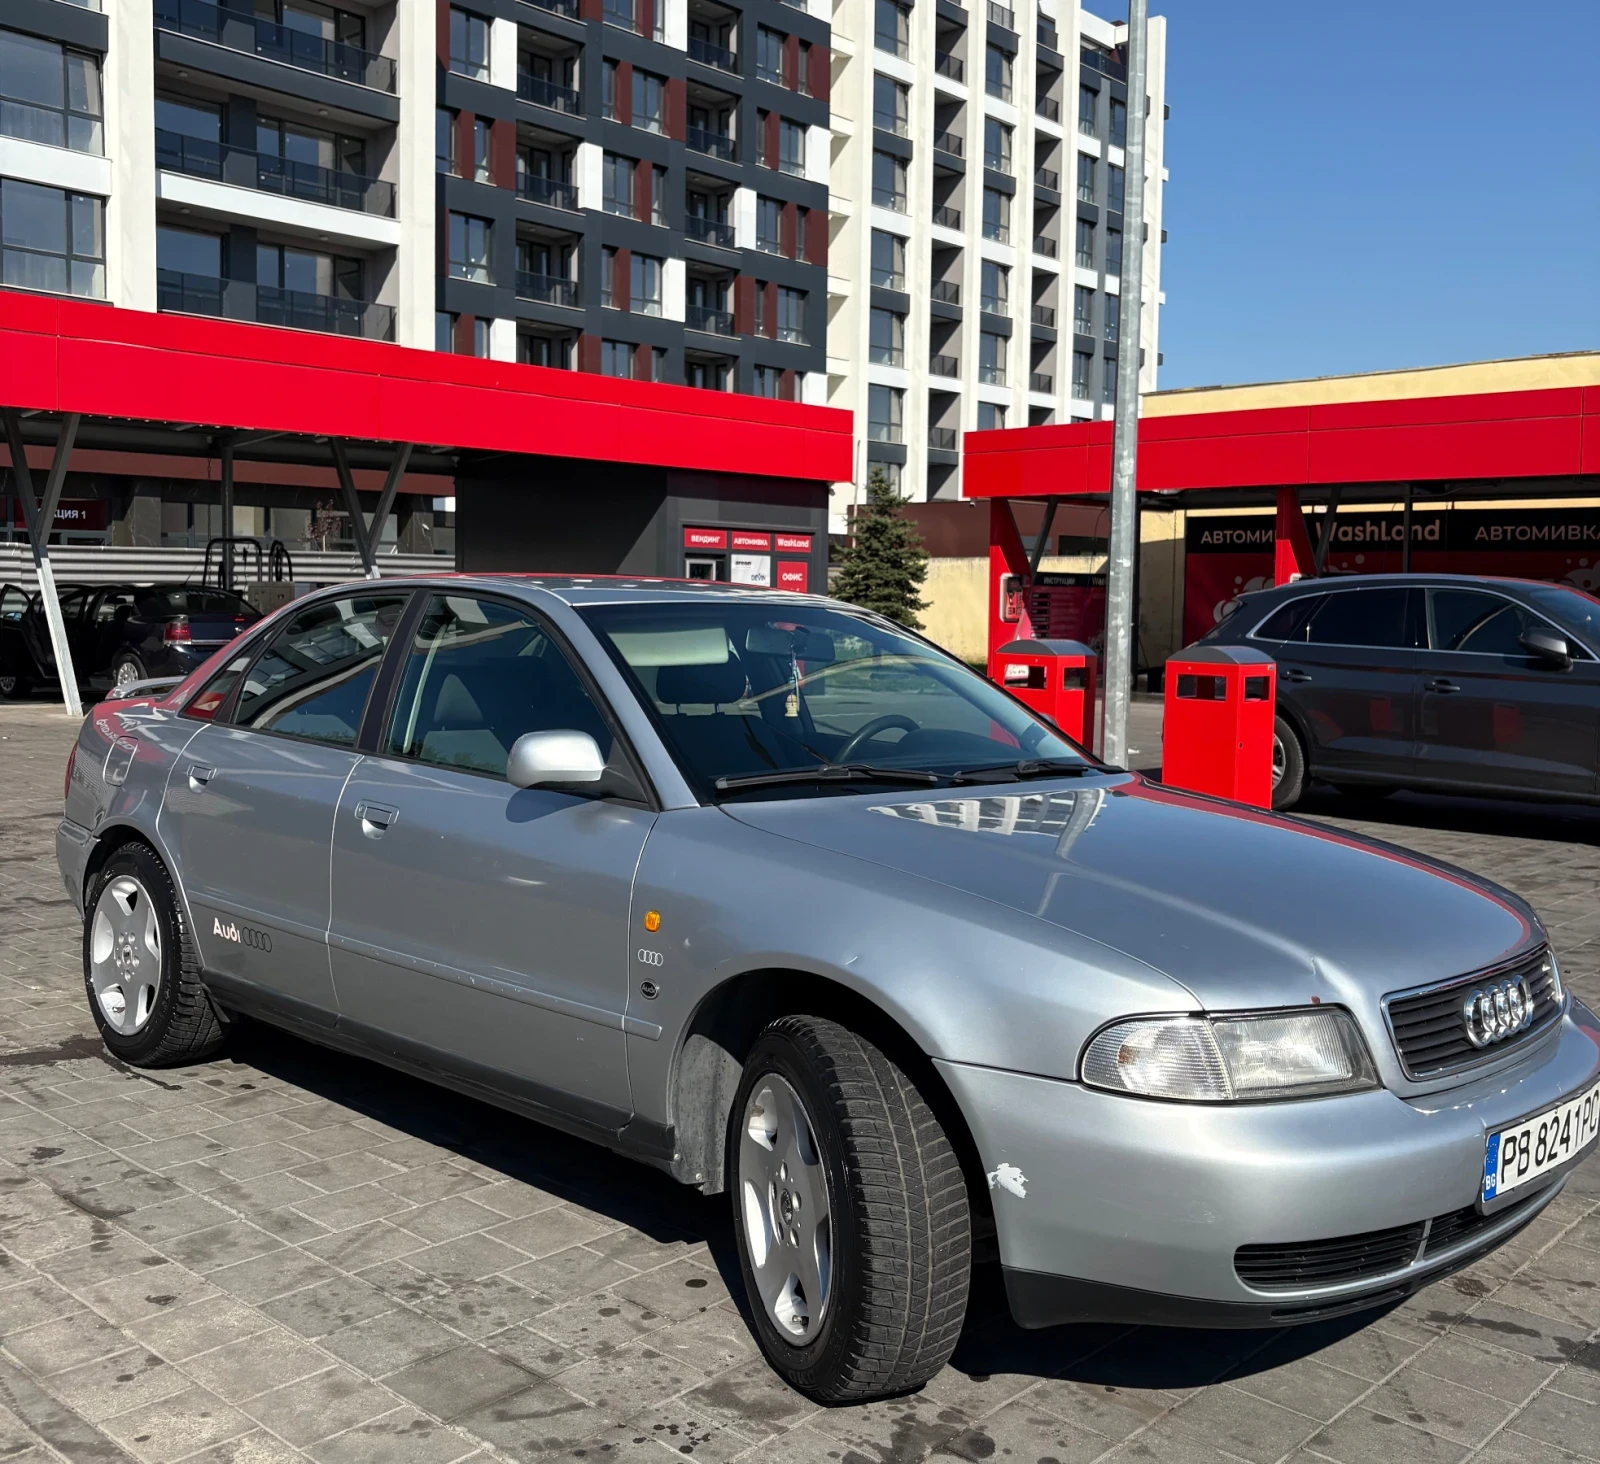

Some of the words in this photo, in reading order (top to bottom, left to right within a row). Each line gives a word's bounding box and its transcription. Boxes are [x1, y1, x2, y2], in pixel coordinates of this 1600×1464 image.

[81, 510, 86, 519] 1
[1201, 529, 1277, 544] АВТОМИ
[1474, 524, 1600, 541] АВТОМИВК
[691, 535, 720, 544] ВЕНДИНГ
[733, 537, 768, 546] АВТОМИВКА
[777, 538, 809, 548] WashLand
[782, 572, 803, 582] ОФИС
[213, 917, 241, 943] Audi
[1486, 1174, 1496, 1190] BG
